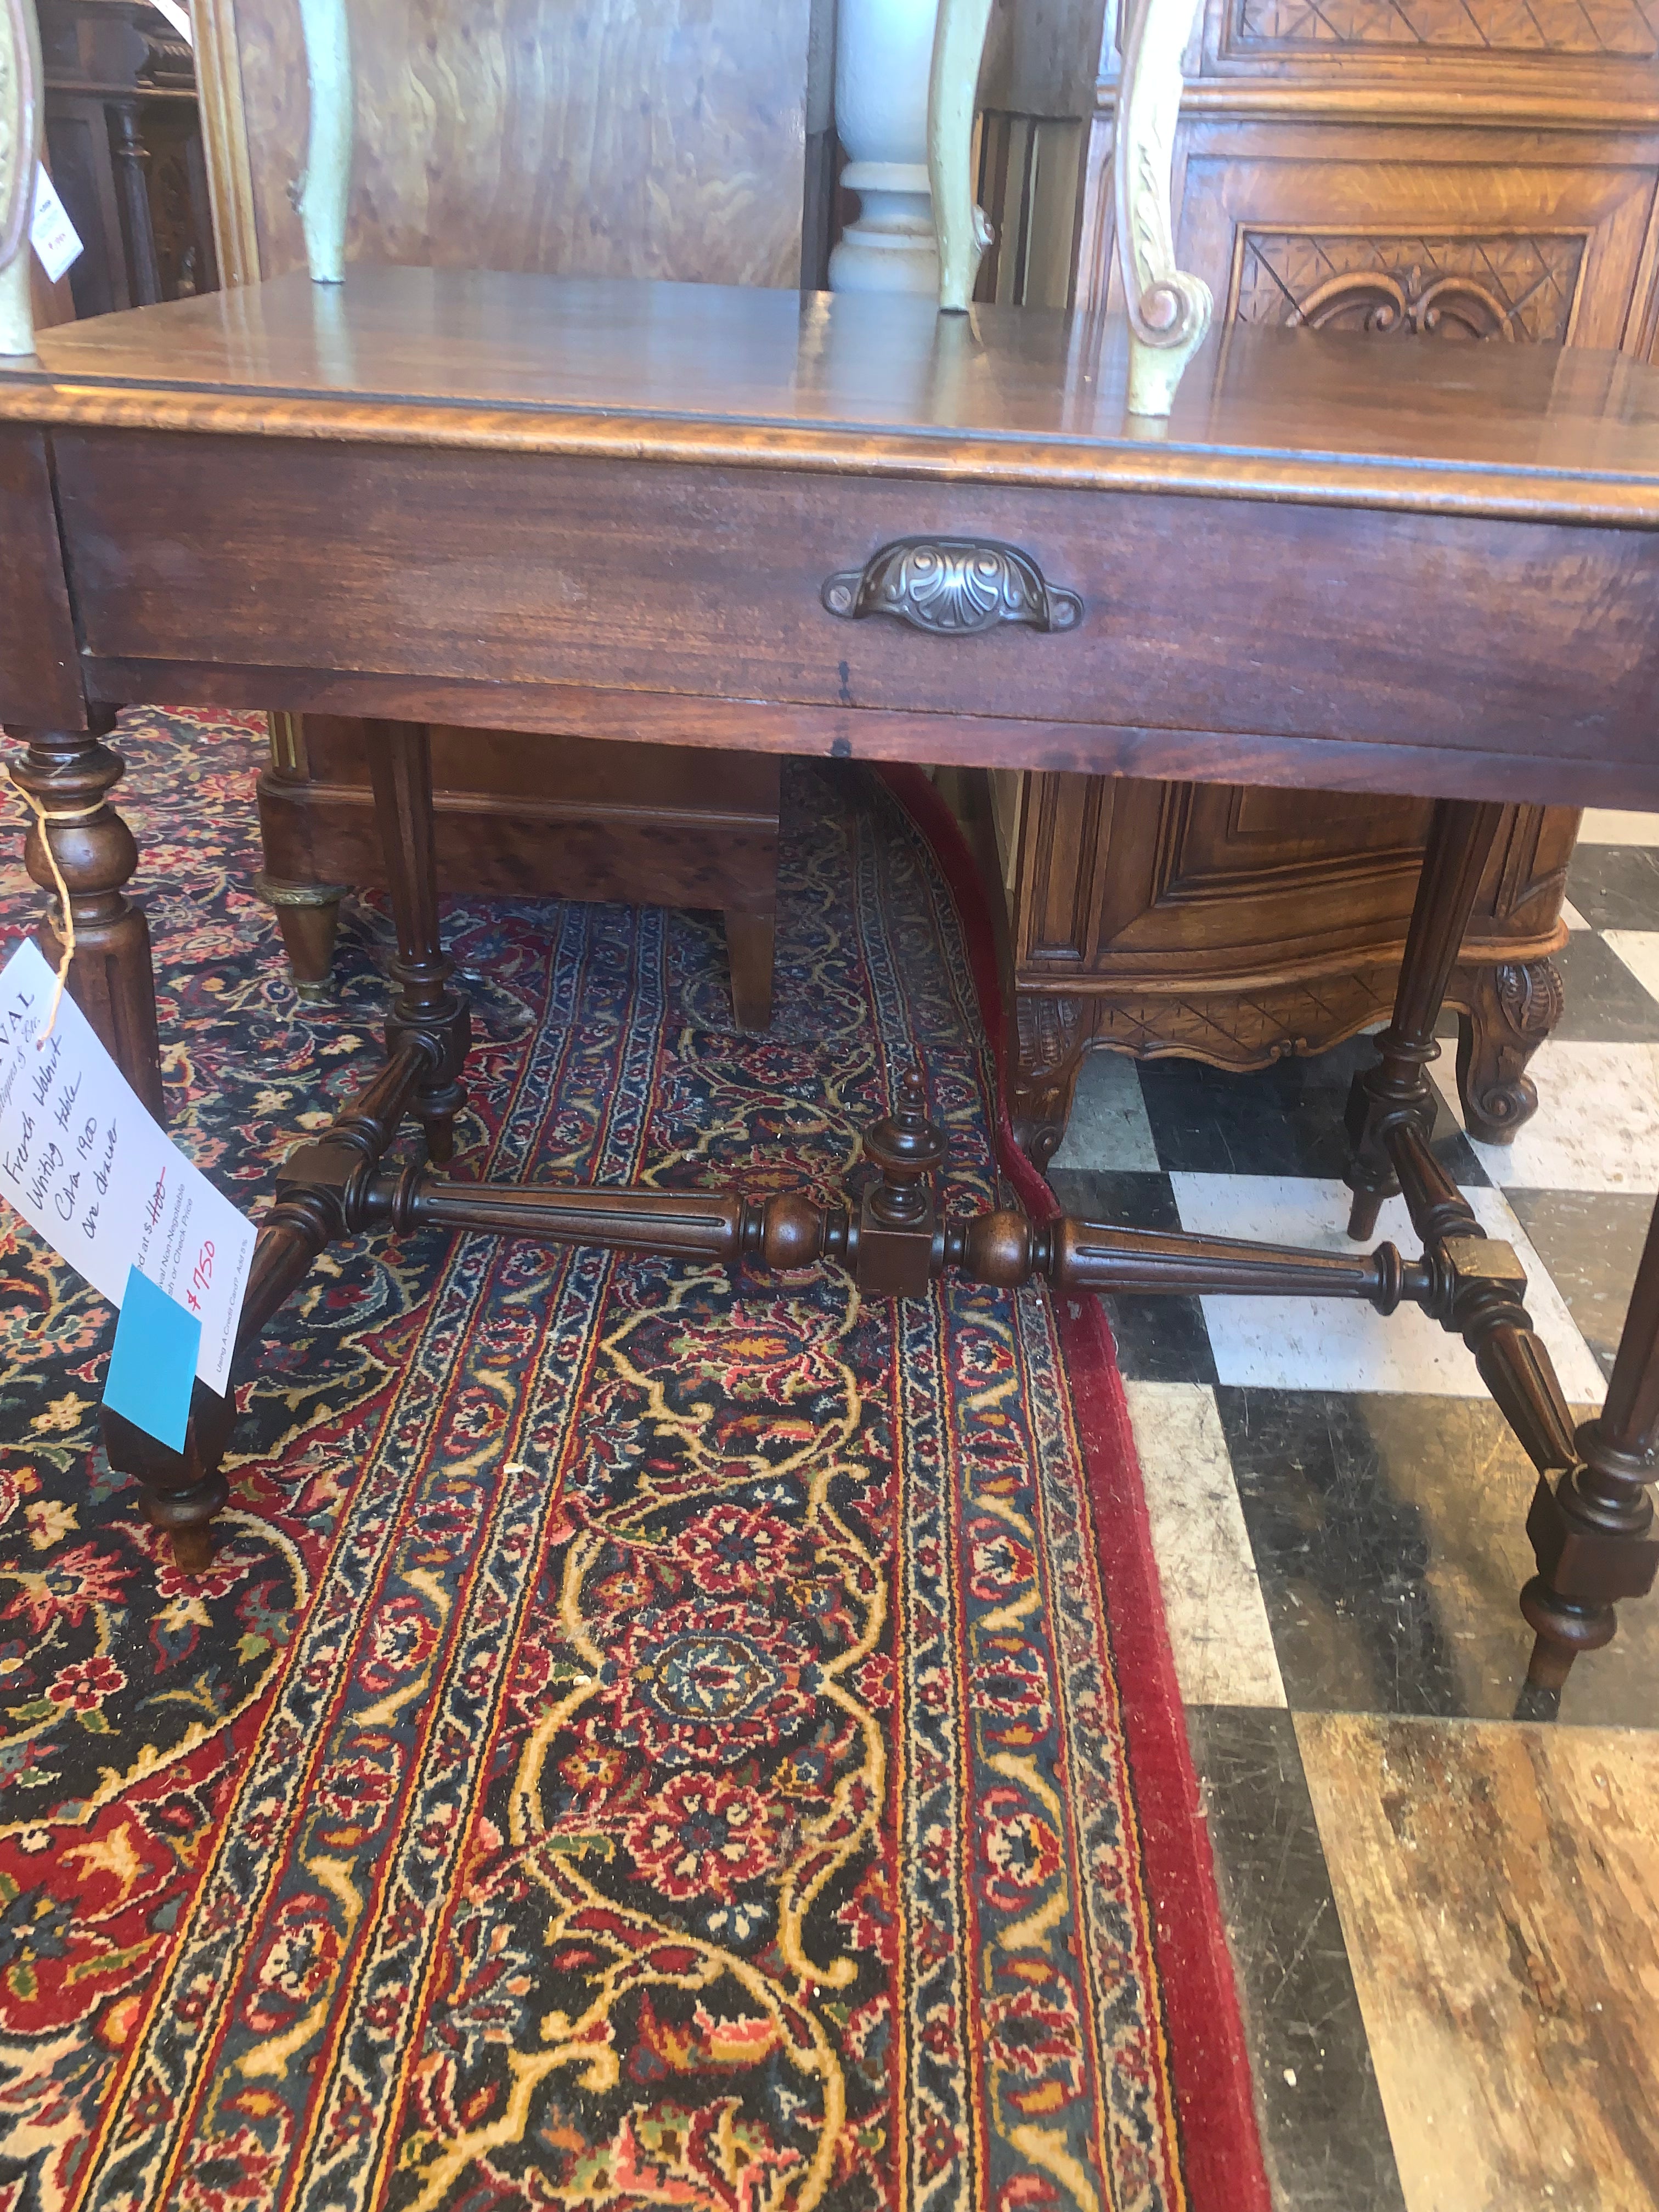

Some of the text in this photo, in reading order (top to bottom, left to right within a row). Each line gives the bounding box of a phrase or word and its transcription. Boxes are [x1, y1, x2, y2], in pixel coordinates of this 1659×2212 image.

[0, 991, 35, 1064] VAL
[3, 1034, 62, 1185] French Walnut
[54, 1071, 82, 1132] table
[76, 1117, 97, 1161] 1900
[93, 1118, 117, 1195] drawer
[157, 1183, 185, 1289] ival Non-Negotiable
[181, 1198, 193, 1227] Price
[137, 1252, 145, 1272] ed
[142, 1236, 150, 1253] at
[172, 1267, 178, 1279] or
[173, 1229, 186, 1264] Check
[216, 1347, 227, 1373] Using
[224, 1307, 234, 1336] Credit
[229, 1277, 239, 1306] Card?
